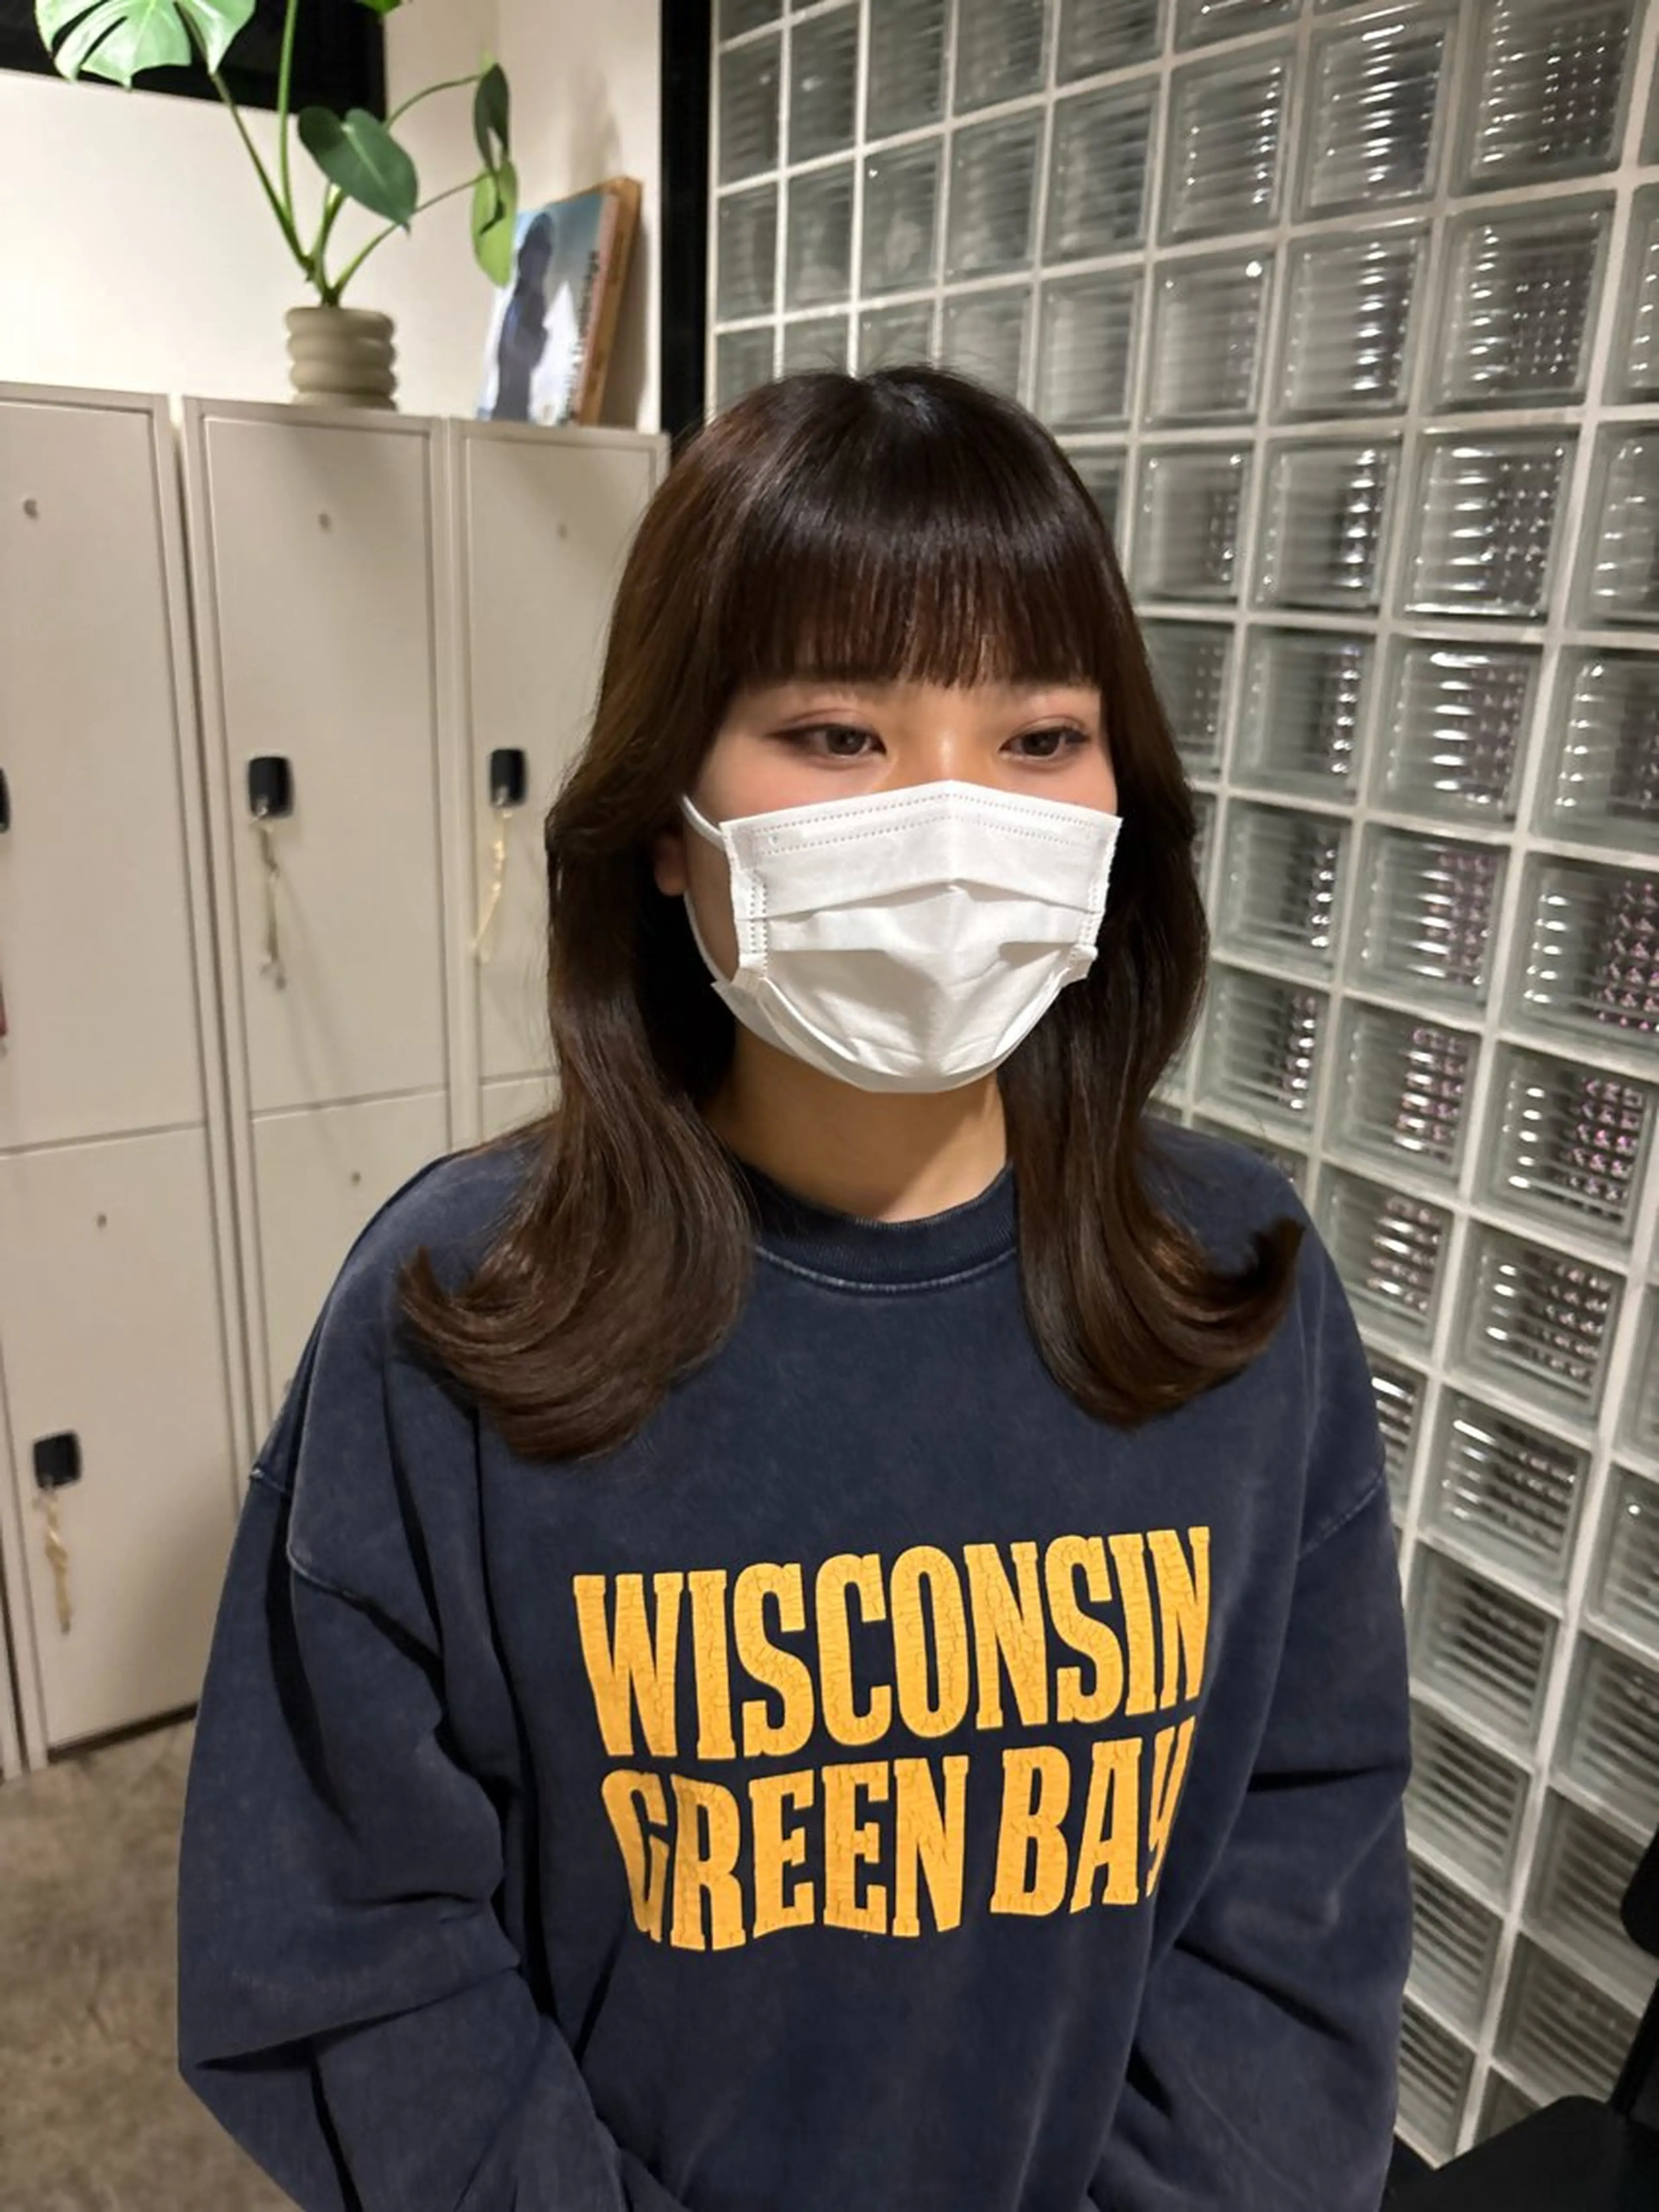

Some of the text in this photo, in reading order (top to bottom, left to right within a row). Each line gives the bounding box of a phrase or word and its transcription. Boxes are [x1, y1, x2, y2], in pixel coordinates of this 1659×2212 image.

[573, 1526, 1211, 1761] WISCONSIN
[601, 1716, 1196, 1951] GREEN BAY
